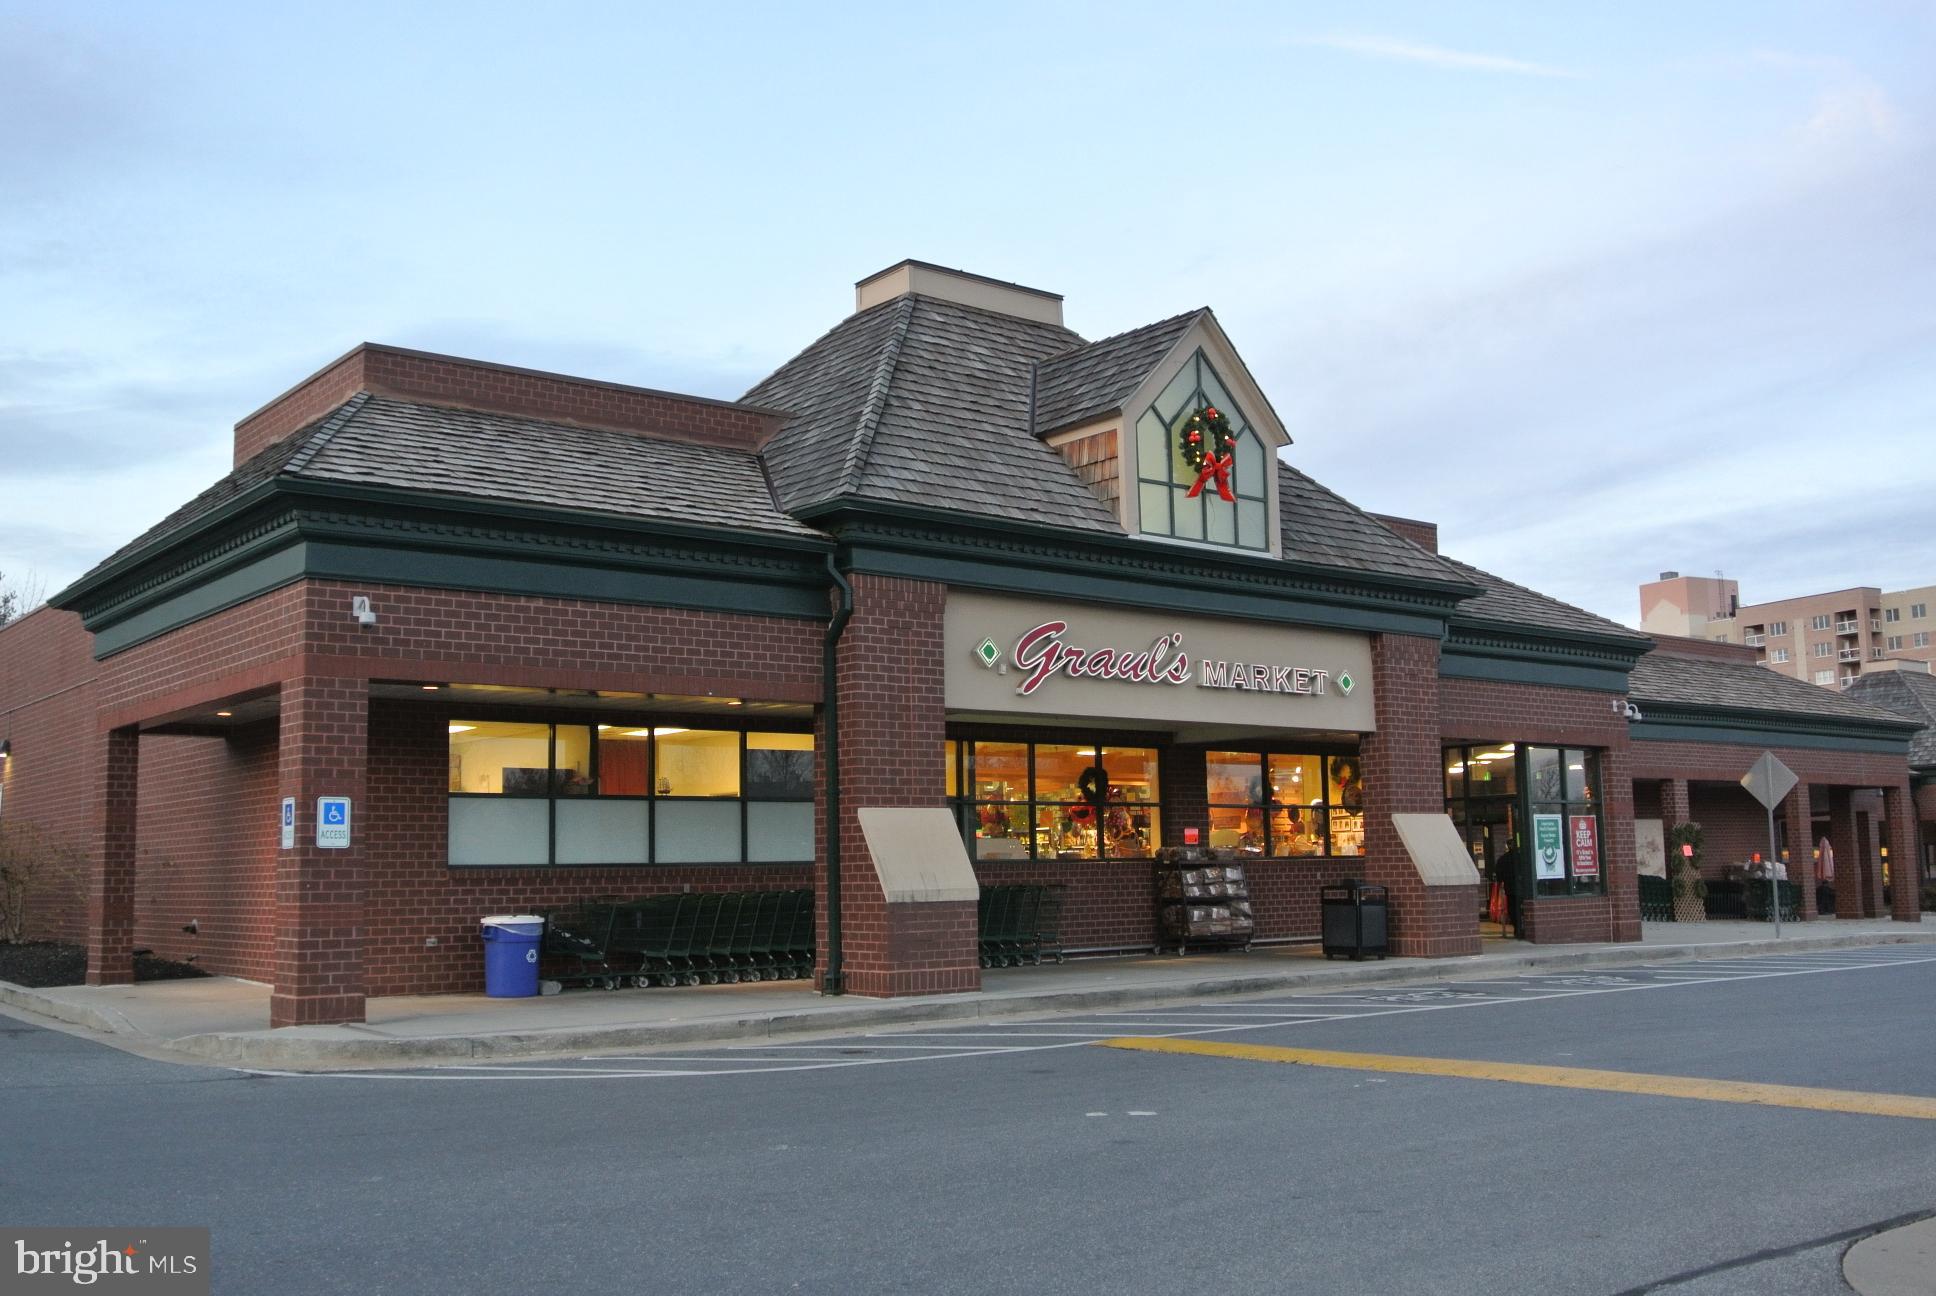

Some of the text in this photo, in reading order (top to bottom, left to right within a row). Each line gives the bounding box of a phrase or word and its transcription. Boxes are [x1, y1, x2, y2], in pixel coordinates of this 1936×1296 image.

[1013, 620, 1329, 695] Graul's MARKET
[320, 830, 346, 840] ACCESS
[1576, 830, 1591, 838] KEEP
[1576, 838, 1593, 847] CALM
